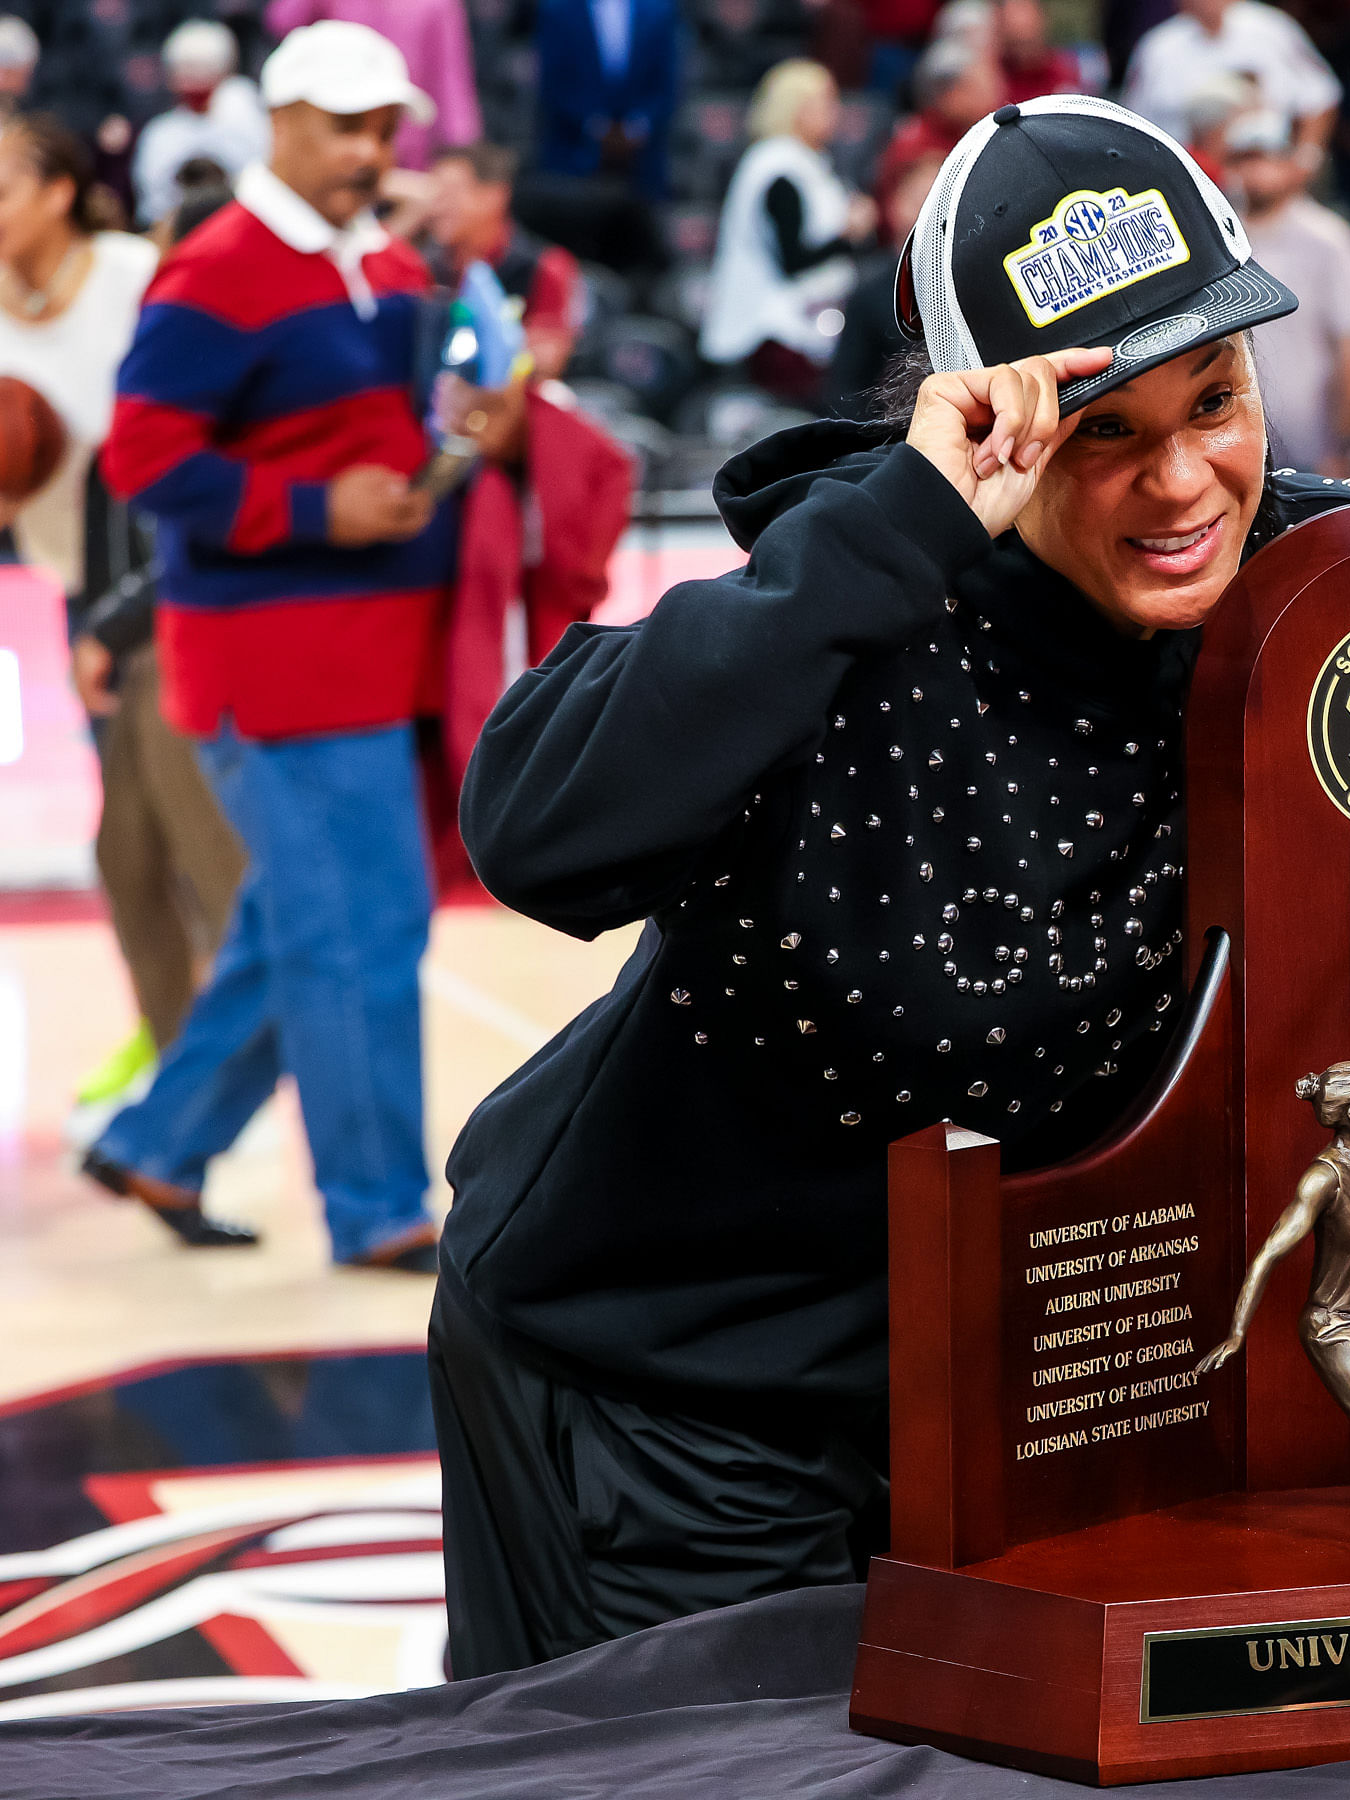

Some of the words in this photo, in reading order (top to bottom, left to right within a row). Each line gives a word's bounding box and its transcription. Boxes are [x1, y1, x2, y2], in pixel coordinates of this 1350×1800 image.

[1039, 225, 1058, 244] 20
[1064, 201, 1105, 240] SEC
[1108, 195, 1126, 212] 23
[1020, 207, 1175, 308] CHAMPIONS
[1051, 281, 1104, 313] WOMEN'S
[1108, 253, 1173, 286] BASKETBALL
[1029, 1218, 1108, 1249] UNIVERSITY
[1112, 1215, 1130, 1233] OF
[1133, 1202, 1195, 1230] ALABAMA
[1025, 1254, 1104, 1285] UNIVERSITY
[1108, 1250, 1126, 1268] OF
[1129, 1235, 1199, 1264] ARKANSAS
[1045, 1289, 1101, 1316] AUBURN
[1104, 1272, 1181, 1304] UNIVERSITY
[1033, 1321, 1112, 1353] UNIVERSITY
[1115, 1316, 1134, 1334] OF
[1136, 1304, 1192, 1330] FLORIDA
[1032, 1355, 1111, 1387] UNIVERSITY
[1114, 1351, 1133, 1369] OF
[1136, 1337, 1194, 1364] GEORGIA
[1026, 1391, 1105, 1423] UNIVERSITY
[1109, 1386, 1127, 1404] OF
[1130, 1370, 1199, 1400] KENTUCKY
[1016, 1430, 1088, 1460] LOUISIANA
[1091, 1419, 1131, 1443] STATE
[1134, 1400, 1210, 1432] UNIVERSITY
